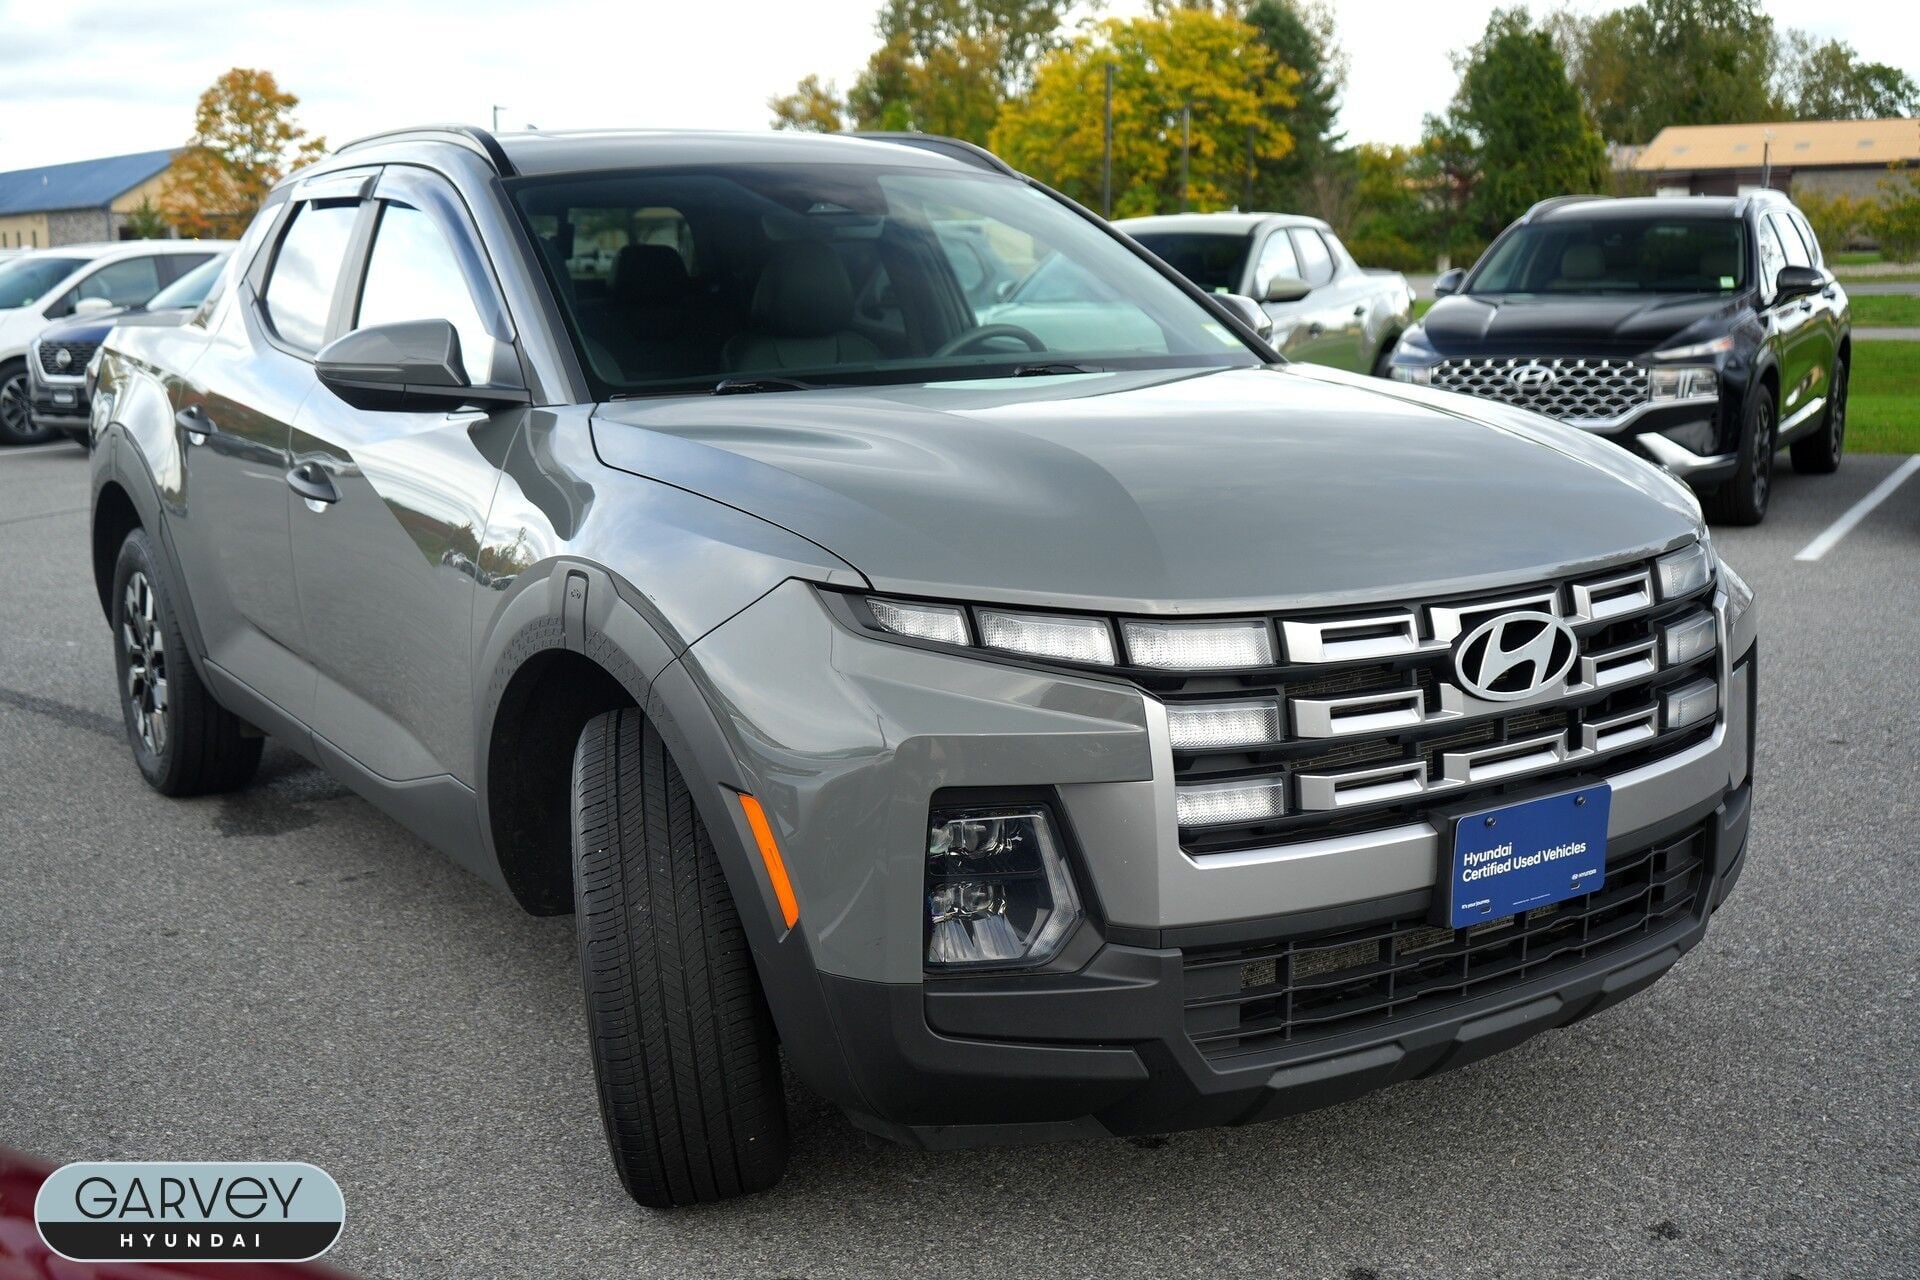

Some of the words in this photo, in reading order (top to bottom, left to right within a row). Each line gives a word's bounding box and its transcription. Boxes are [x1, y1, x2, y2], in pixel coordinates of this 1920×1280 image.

[1462, 859, 1511, 882] Certified
[1513, 851, 1541, 869] Used
[1542, 842, 1587, 862] Vehicles
[1464, 842, 1512, 866] Hyundai
